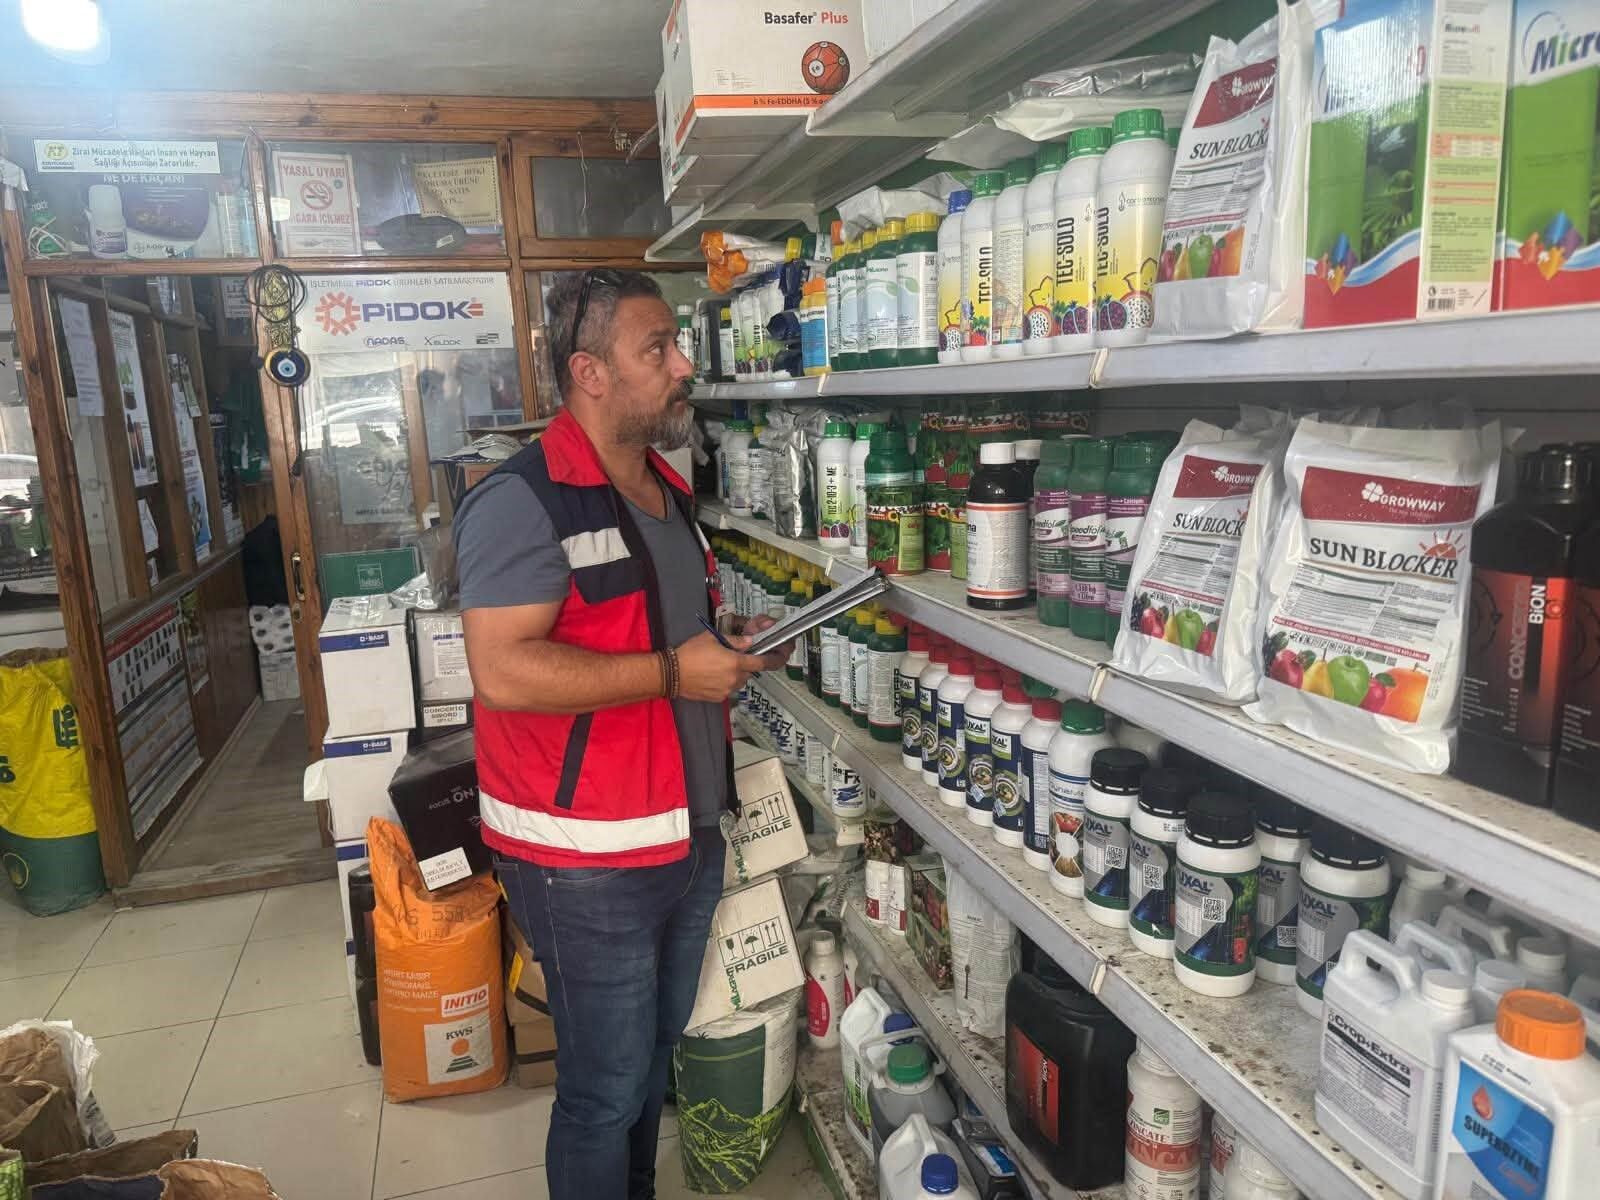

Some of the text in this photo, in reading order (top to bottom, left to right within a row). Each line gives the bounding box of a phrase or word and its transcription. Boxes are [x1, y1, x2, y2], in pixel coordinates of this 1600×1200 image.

[820, 11, 849, 25] Plus
[1189, 138, 1225, 160] SUN
[282, 163, 346, 178] YASAL UYARI
[826, 465, 838, 477] ME
[1380, 494, 1446, 513] GROWWAY
[1070, 524, 1101, 535] peedfol
[1172, 512, 1247, 537] SUN BLOCK
[1310, 537, 1459, 579] SUN BLOCKER
[1527, 583, 1547, 625] BiON
[967, 719, 987, 734] UXAL
[452, 787, 475, 803] ON
[731, 819, 793, 848] FRAGILE
[1085, 816, 1113, 836] UXAL
[1181, 870, 1212, 894] UXAL
[1301, 893, 1338, 918] UXAL
[726, 944, 789, 977] FRAGILE
[443, 988, 488, 1010] INITIO
[446, 1026, 473, 1041] KWS
[1334, 1014, 1412, 1076] Crop+Extra
